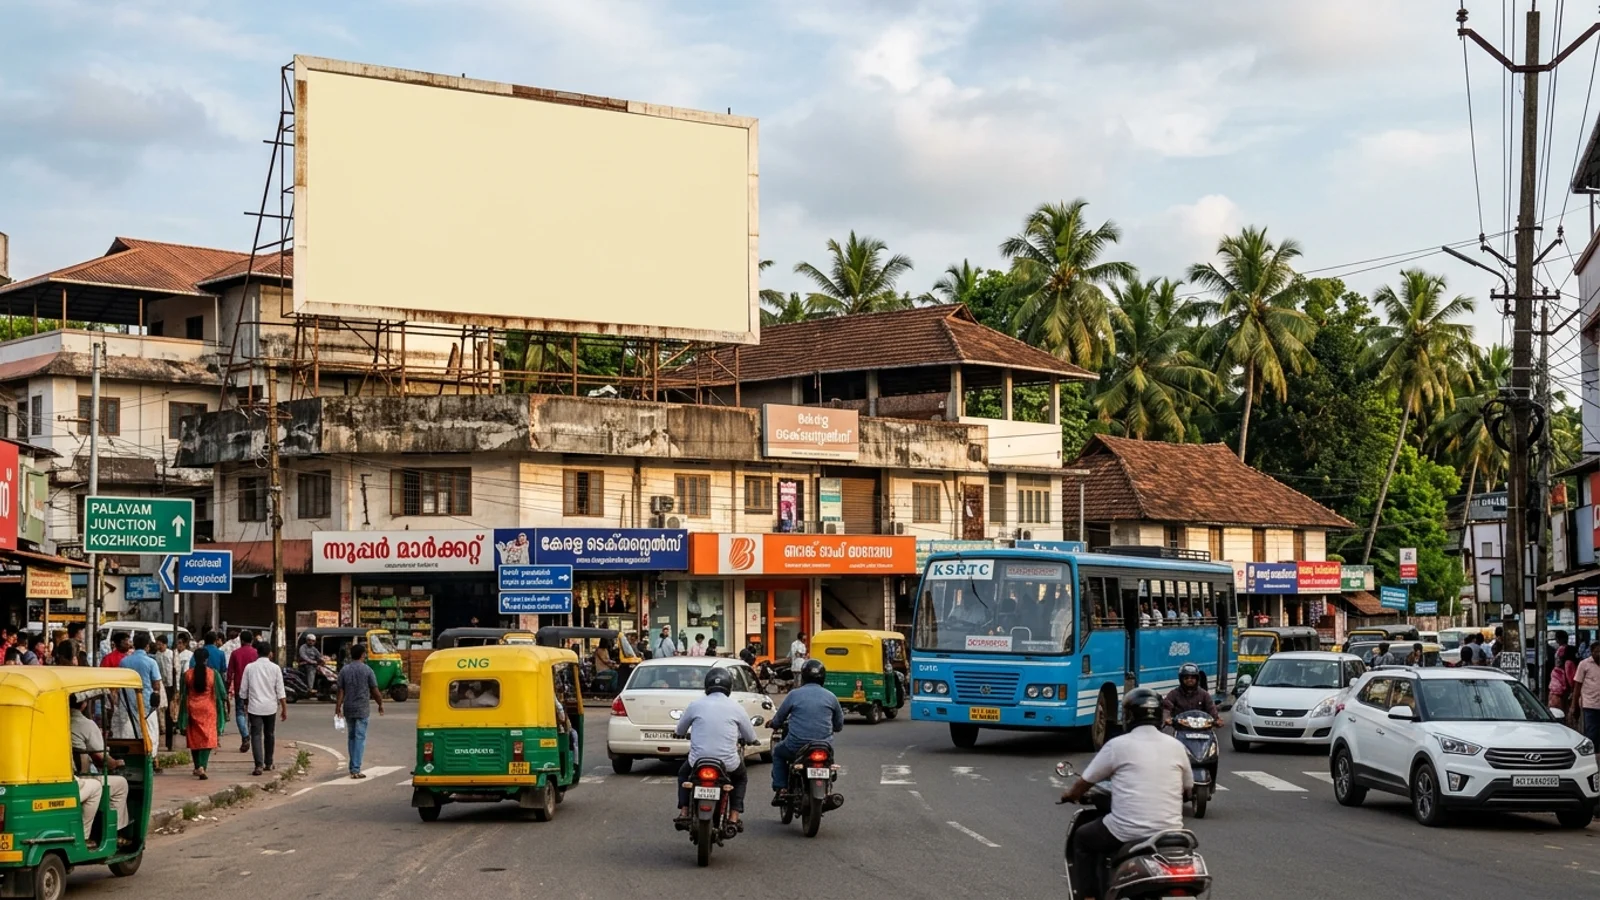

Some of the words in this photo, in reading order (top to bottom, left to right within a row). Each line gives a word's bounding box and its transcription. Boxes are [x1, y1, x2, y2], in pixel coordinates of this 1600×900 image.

[91, 502, 152, 515] PALAYAM
[90, 518, 156, 531] JUNCTION
[90, 534, 166, 547] KOZHIKODE
[541, 536, 583, 555] കേരള
[397, 534, 485, 565] മാർക്കറ്റ്
[933, 563, 989, 576] KSRTC
[456, 657, 490, 669] CNG
